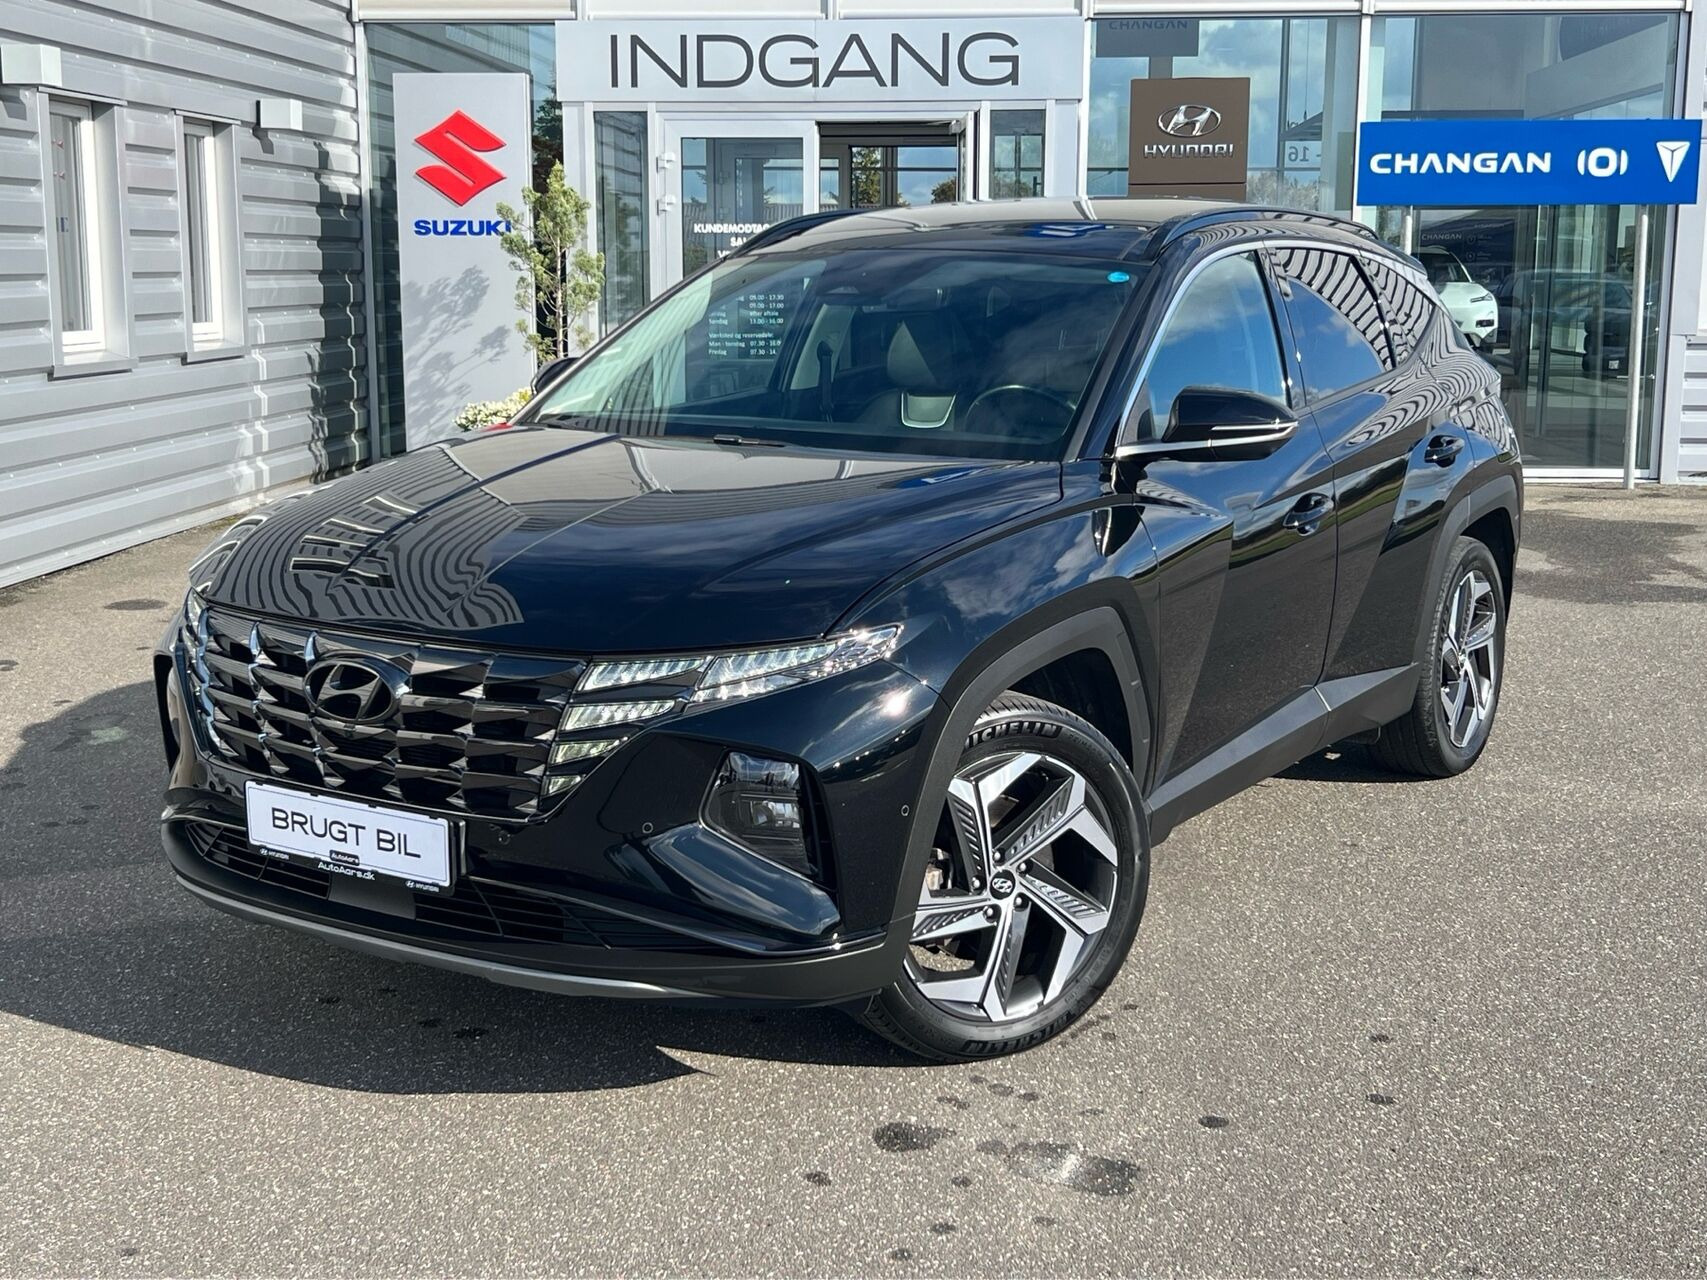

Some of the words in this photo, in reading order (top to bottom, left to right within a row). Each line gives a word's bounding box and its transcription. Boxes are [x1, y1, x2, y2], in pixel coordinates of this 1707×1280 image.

[610, 32, 1020, 88] INDGANG
[1144, 144, 1234, 158] HYUNDAI
[1369, 152, 1552, 174] CHANGAN
[414, 219, 512, 236] SUZUKI
[1421, 233, 1462, 241] CHANGAN
[271, 806, 366, 847] BRUGT
[376, 828, 421, 859] BIL
[317, 860, 376, 881] AutoAars.dk
